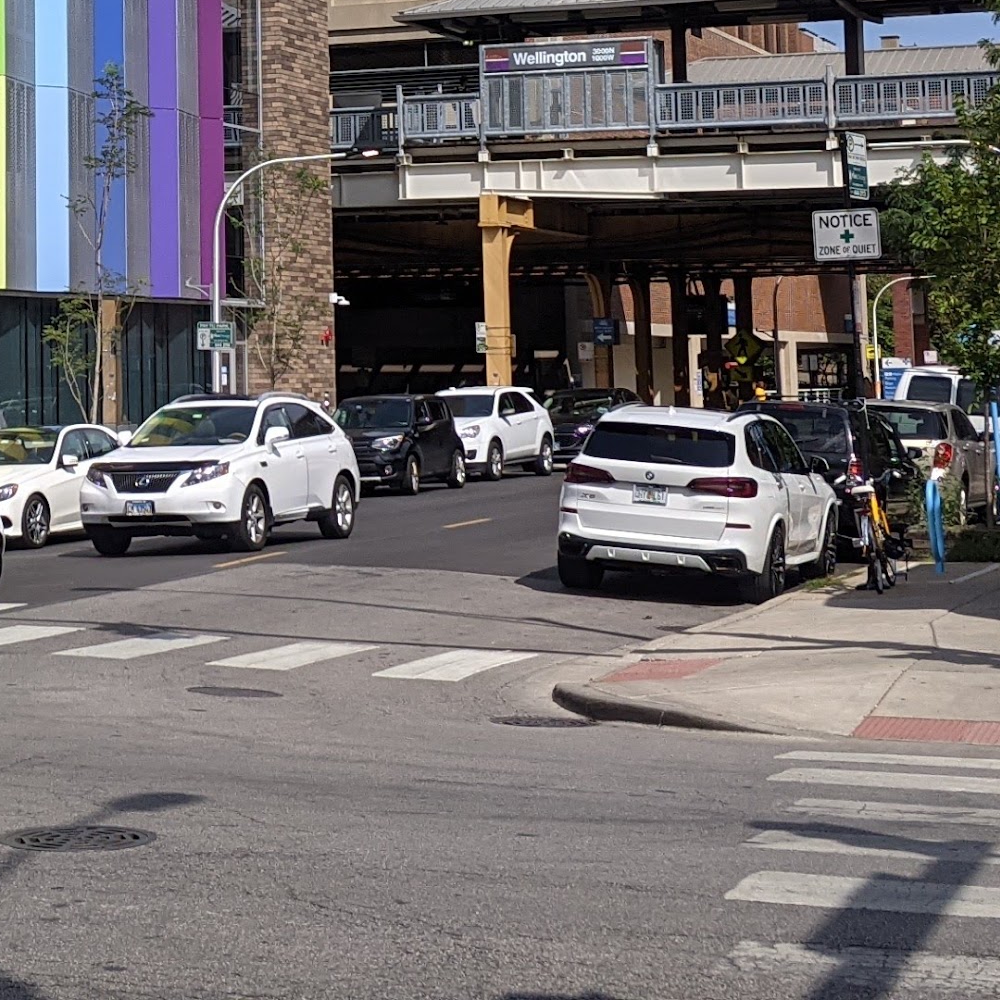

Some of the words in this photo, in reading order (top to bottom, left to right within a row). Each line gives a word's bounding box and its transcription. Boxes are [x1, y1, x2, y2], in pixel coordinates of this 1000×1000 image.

[513, 51, 587, 66] Wellington
[819, 213, 873, 229] NOTICE
[819, 246, 841, 256] ZONE
[852, 244, 877, 254] QUIET
